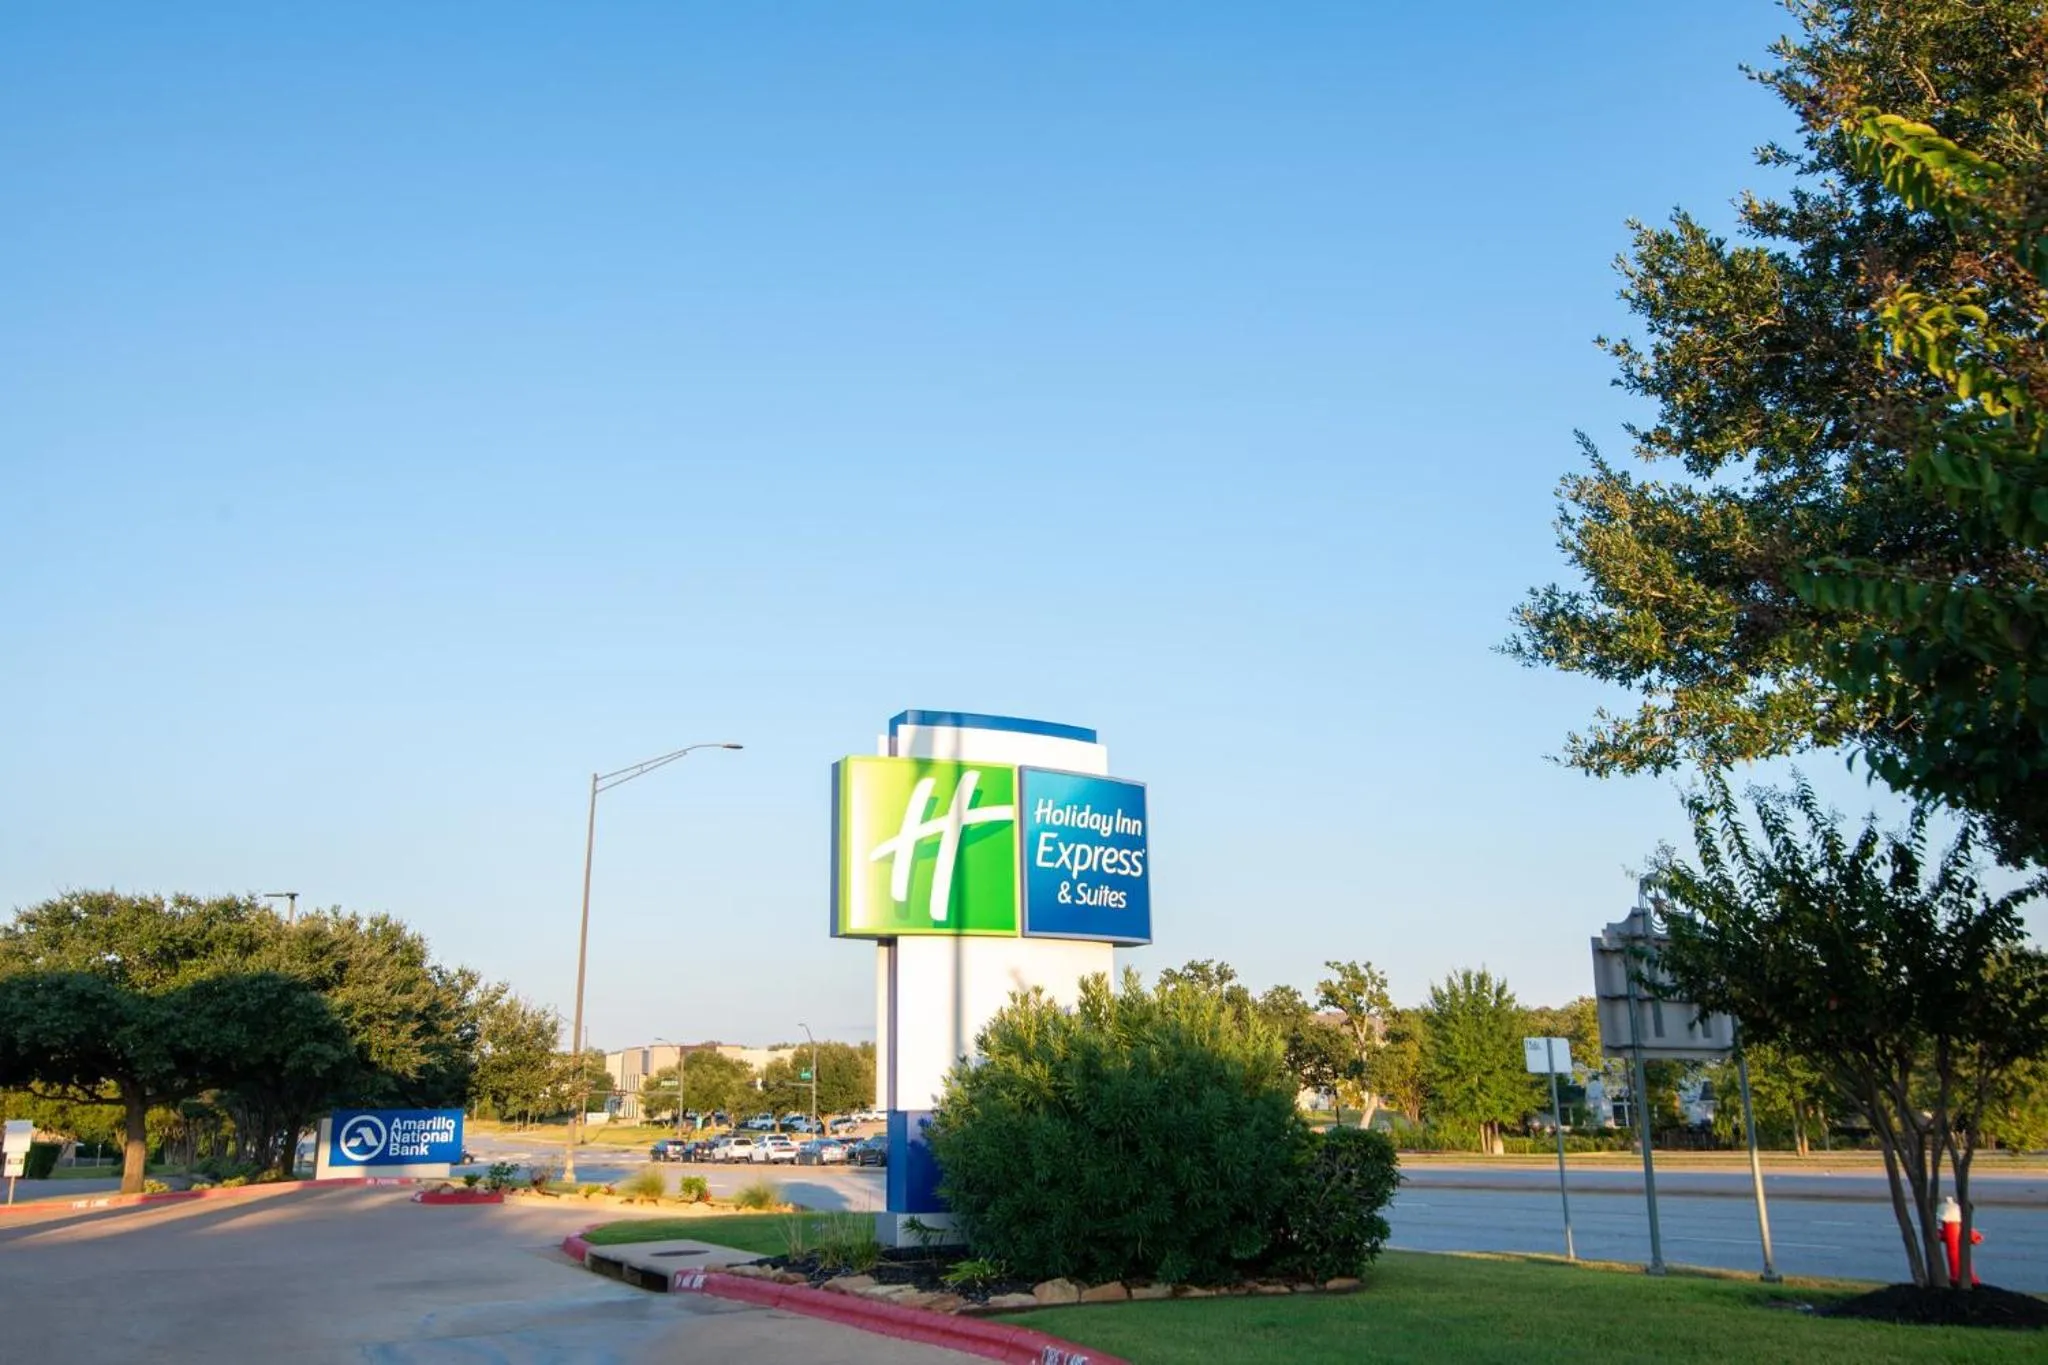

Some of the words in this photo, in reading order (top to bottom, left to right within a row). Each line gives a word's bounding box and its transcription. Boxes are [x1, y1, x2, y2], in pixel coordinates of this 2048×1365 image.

[1034, 798, 1113, 837] Holiday
[1115, 808, 1142, 836] Inn
[1036, 832, 1143, 880] Express
[1057, 881, 1072, 904] &
[1075, 882, 1127, 908] Suites
[391, 1116, 455, 1130] Amarillo
[391, 1129, 454, 1143] National
[389, 1142, 429, 1156] Bank
